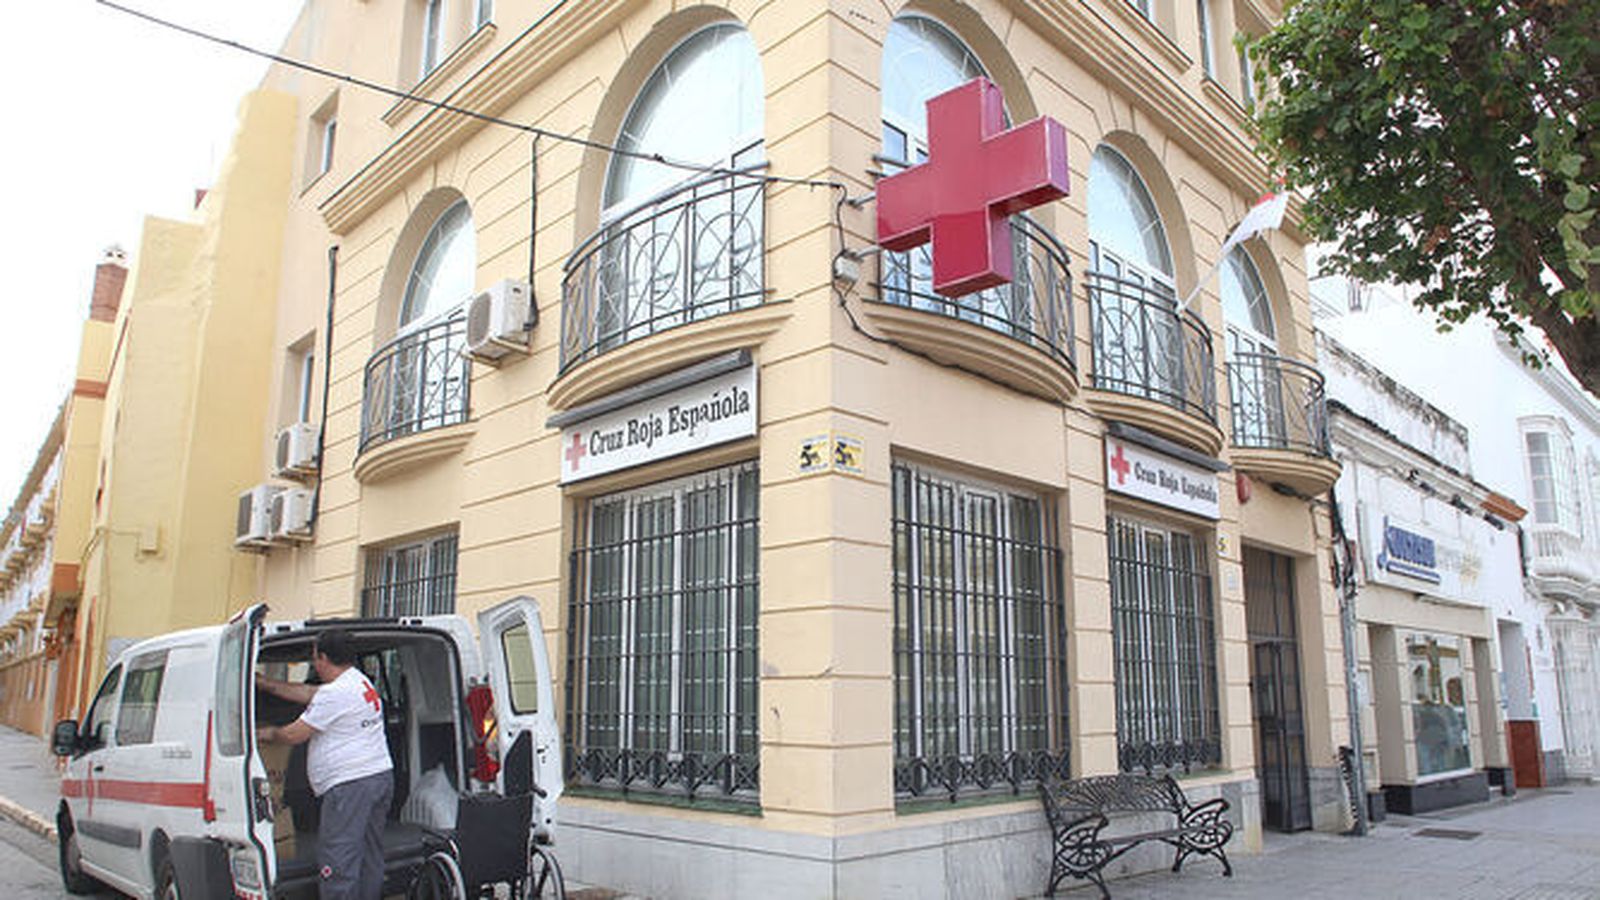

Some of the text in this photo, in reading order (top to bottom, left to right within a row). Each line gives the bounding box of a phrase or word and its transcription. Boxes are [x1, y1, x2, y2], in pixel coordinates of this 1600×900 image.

[589, 386, 750, 456] Cruz Roja Española
[1158, 469, 1178, 494] Roja
